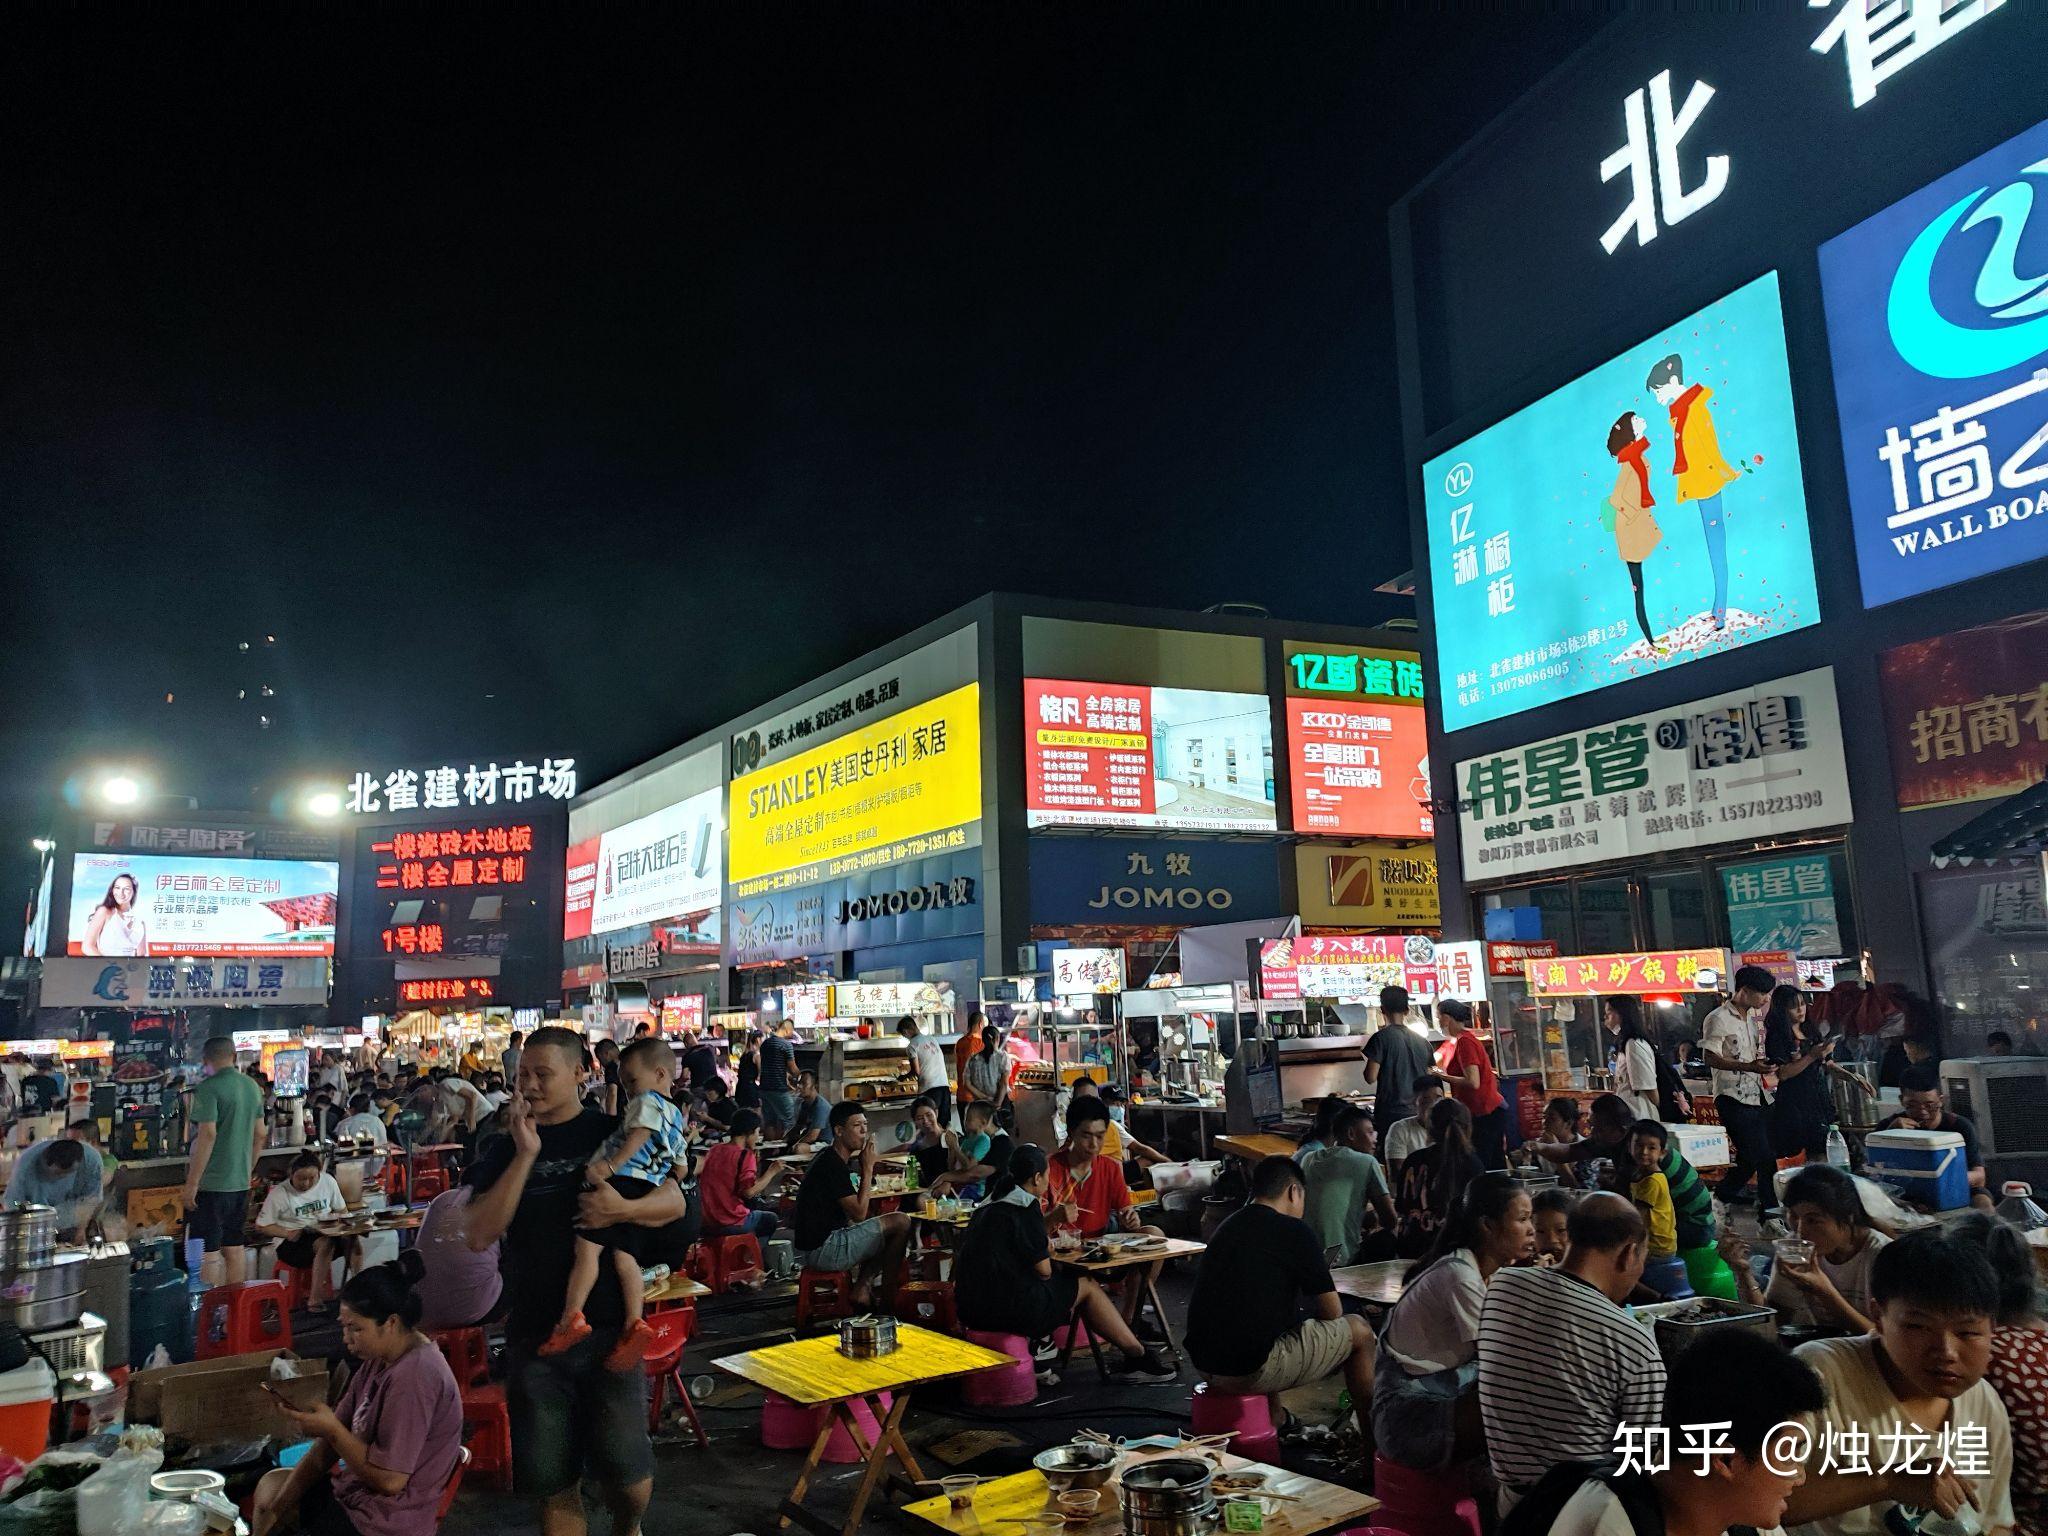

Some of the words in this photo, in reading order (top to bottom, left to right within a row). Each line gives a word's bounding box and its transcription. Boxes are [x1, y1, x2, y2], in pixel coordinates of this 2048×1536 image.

[1449, 470, 1470, 491] YL
[1890, 514, 1983, 557] WALL
[1489, 662, 1570, 696] 13078086905
[1039, 694, 1082, 725] 格凡
[1086, 713, 1142, 732] 高端定制
[1301, 712, 1345, 728] KKD
[346, 758, 577, 813] 北雀建材市场
[1467, 723, 1649, 820] 伟星管
[749, 763, 829, 818] STANLEY
[371, 825, 533, 860] 一楼瓷砖木地板
[376, 855, 526, 890] 二楼全屋定制
[1127, 852, 1192, 877] 九牧
[1728, 862, 1826, 901] 伟星管
[155, 875, 281, 894] 伊百丽全屋定制
[1088, 886, 1233, 910] JOMOO
[382, 924, 443, 953] 1号楼
[1548, 955, 1699, 989] 潮汕砂锅粥
